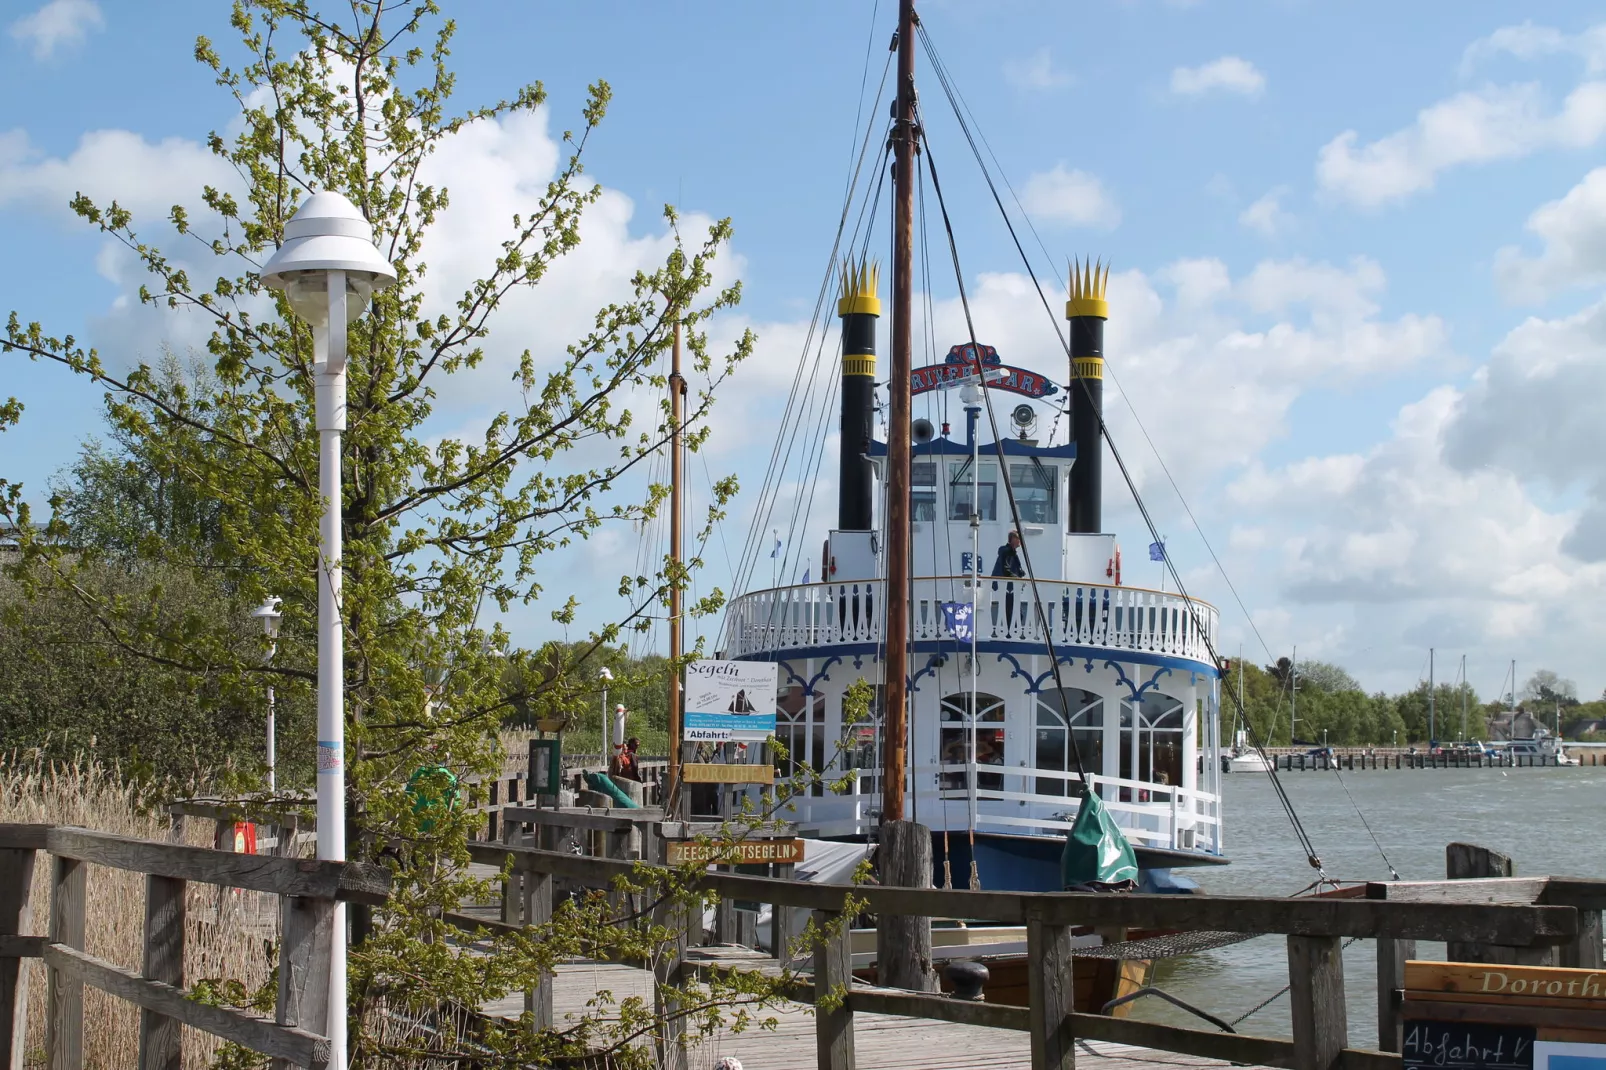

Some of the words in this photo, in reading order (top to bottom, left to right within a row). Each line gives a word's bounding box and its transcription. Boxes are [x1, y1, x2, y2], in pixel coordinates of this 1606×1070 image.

[688, 662, 739, 679] Segeln
[690, 730, 728, 739] Abfahrt:
[689, 765, 769, 782] DOROTHEA
[1480, 971, 1606, 997] Doroth
[1405, 1026, 1503, 1066] Abfahrt
